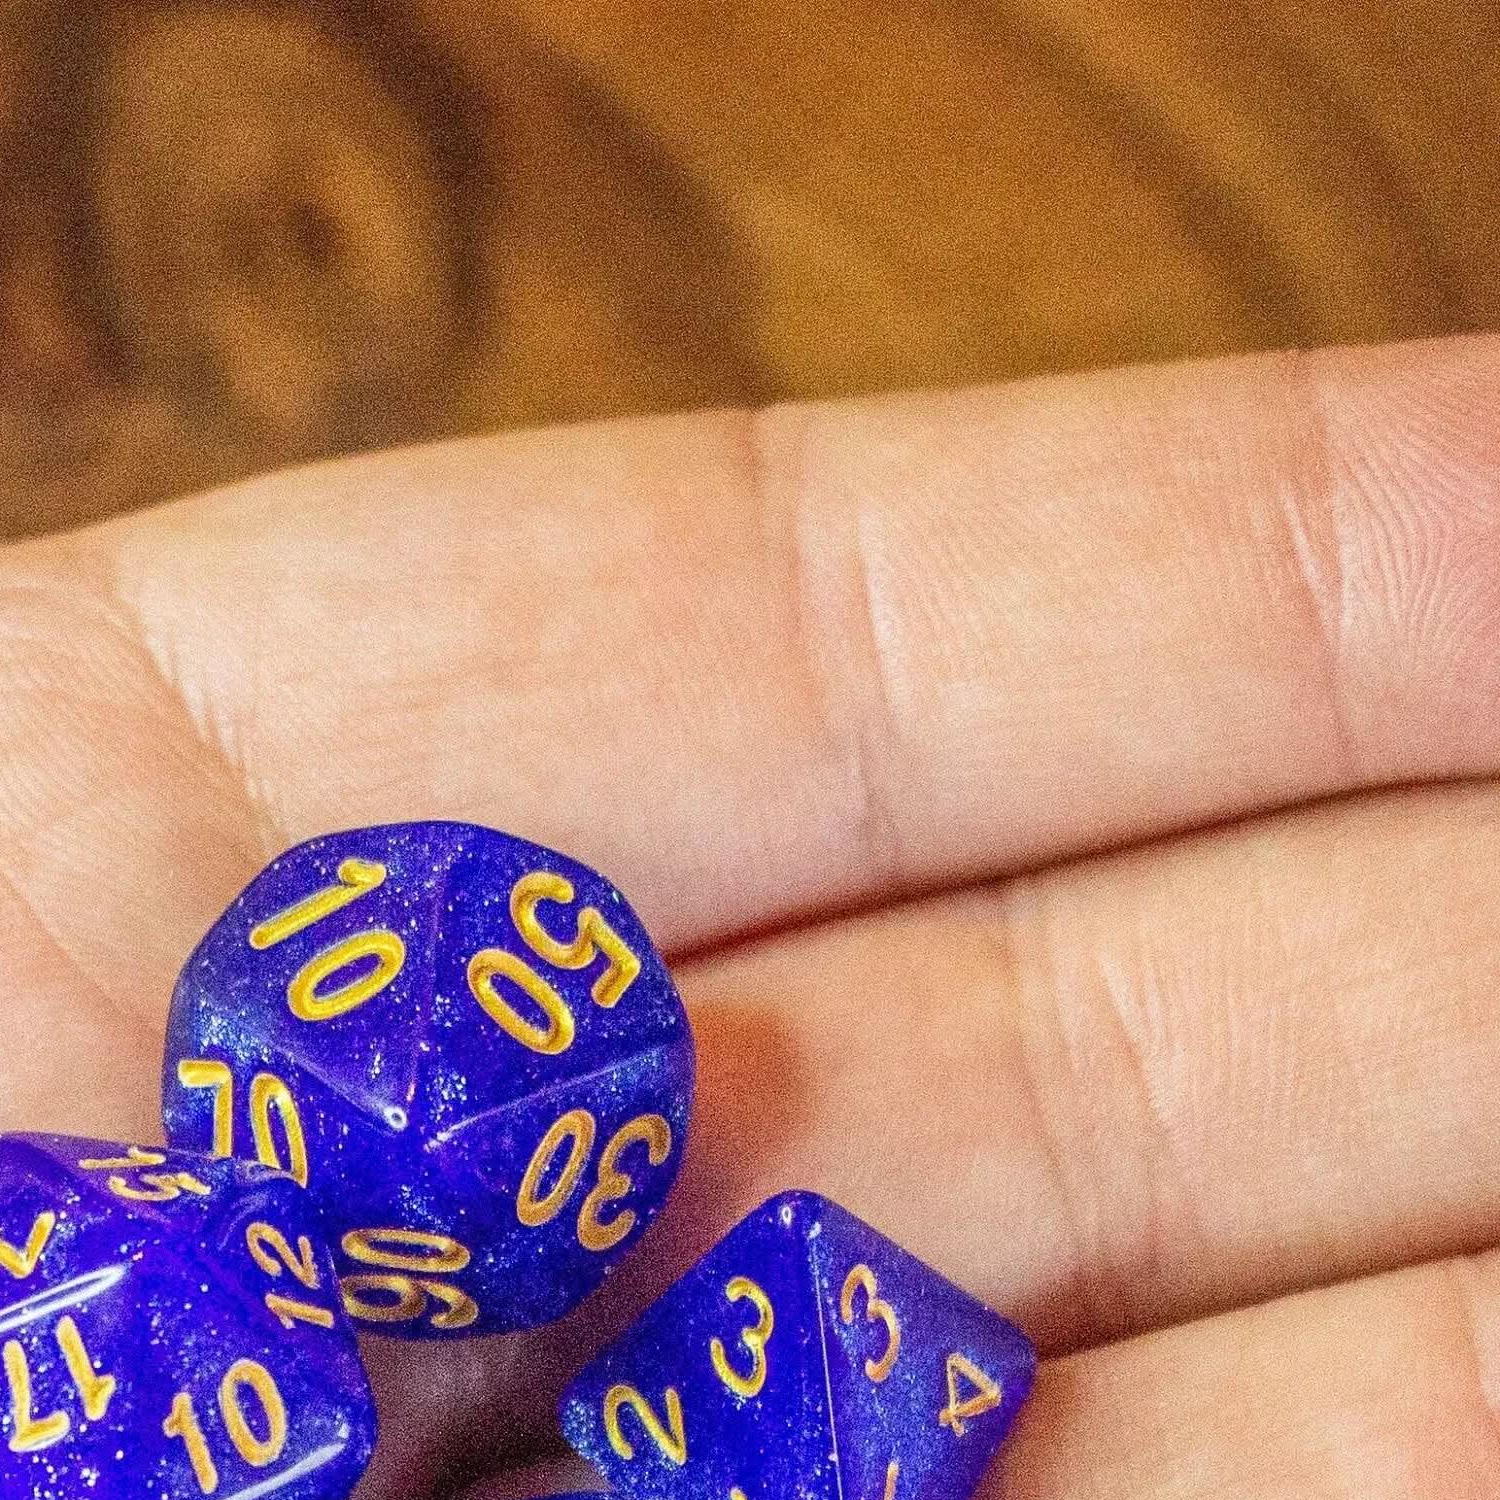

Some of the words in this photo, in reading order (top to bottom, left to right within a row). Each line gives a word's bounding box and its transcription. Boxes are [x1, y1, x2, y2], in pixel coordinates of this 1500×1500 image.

[249, 858, 406, 1022] 10
[467, 871, 642, 1056] 50
[177, 1058, 309, 1189] 70
[515, 1109, 672, 1252] 30
[246, 1222, 334, 1328] 12
[710, 1276, 775, 1398] 3
[839, 1263, 901, 1383] 3
[3, 1316, 116, 1452] 17
[163, 1359, 287, 1494] 10
[603, 1383, 688, 1466] 2
[938, 1352, 1003, 1436] 4
